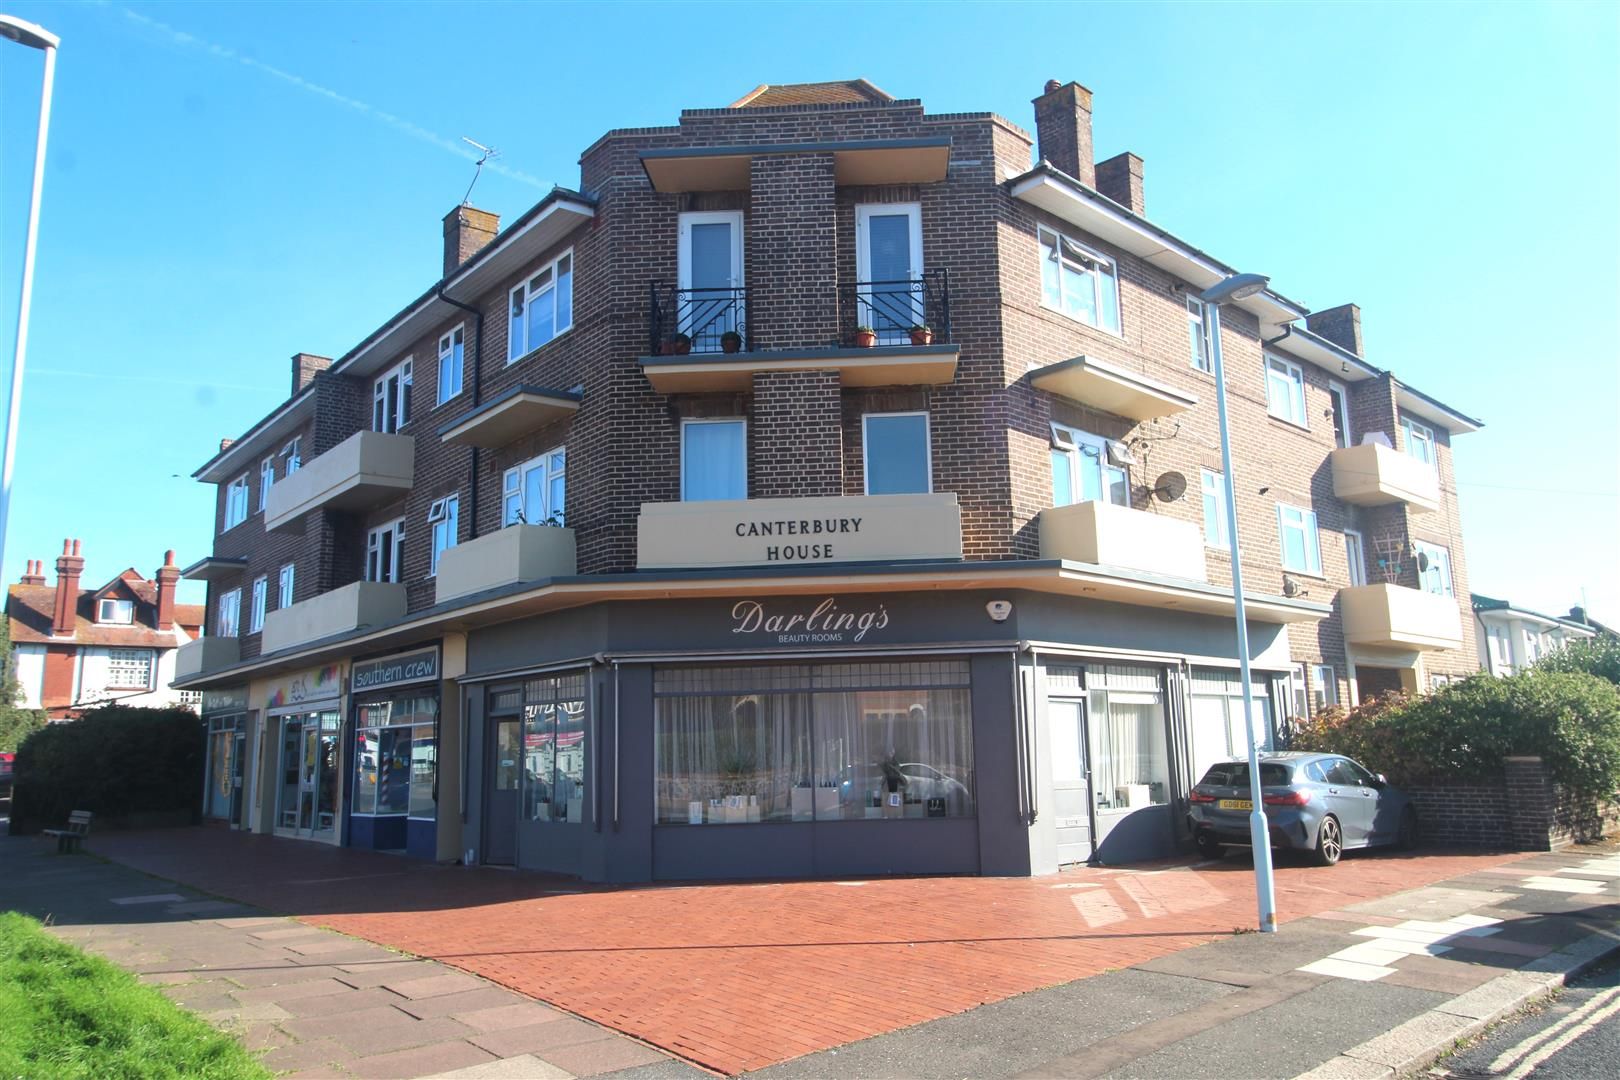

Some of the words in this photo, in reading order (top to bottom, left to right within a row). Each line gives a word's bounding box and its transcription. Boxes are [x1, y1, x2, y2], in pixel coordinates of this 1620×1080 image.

[735, 518, 863, 537] CANTERBURY
[767, 544, 833, 561] HOUSE
[732, 598, 889, 642] Darling's
[778, 634, 811, 643] BEAUTY
[812, 633, 843, 642] ROOMS
[357, 661, 401, 686] southern
[405, 656, 434, 678] crew
